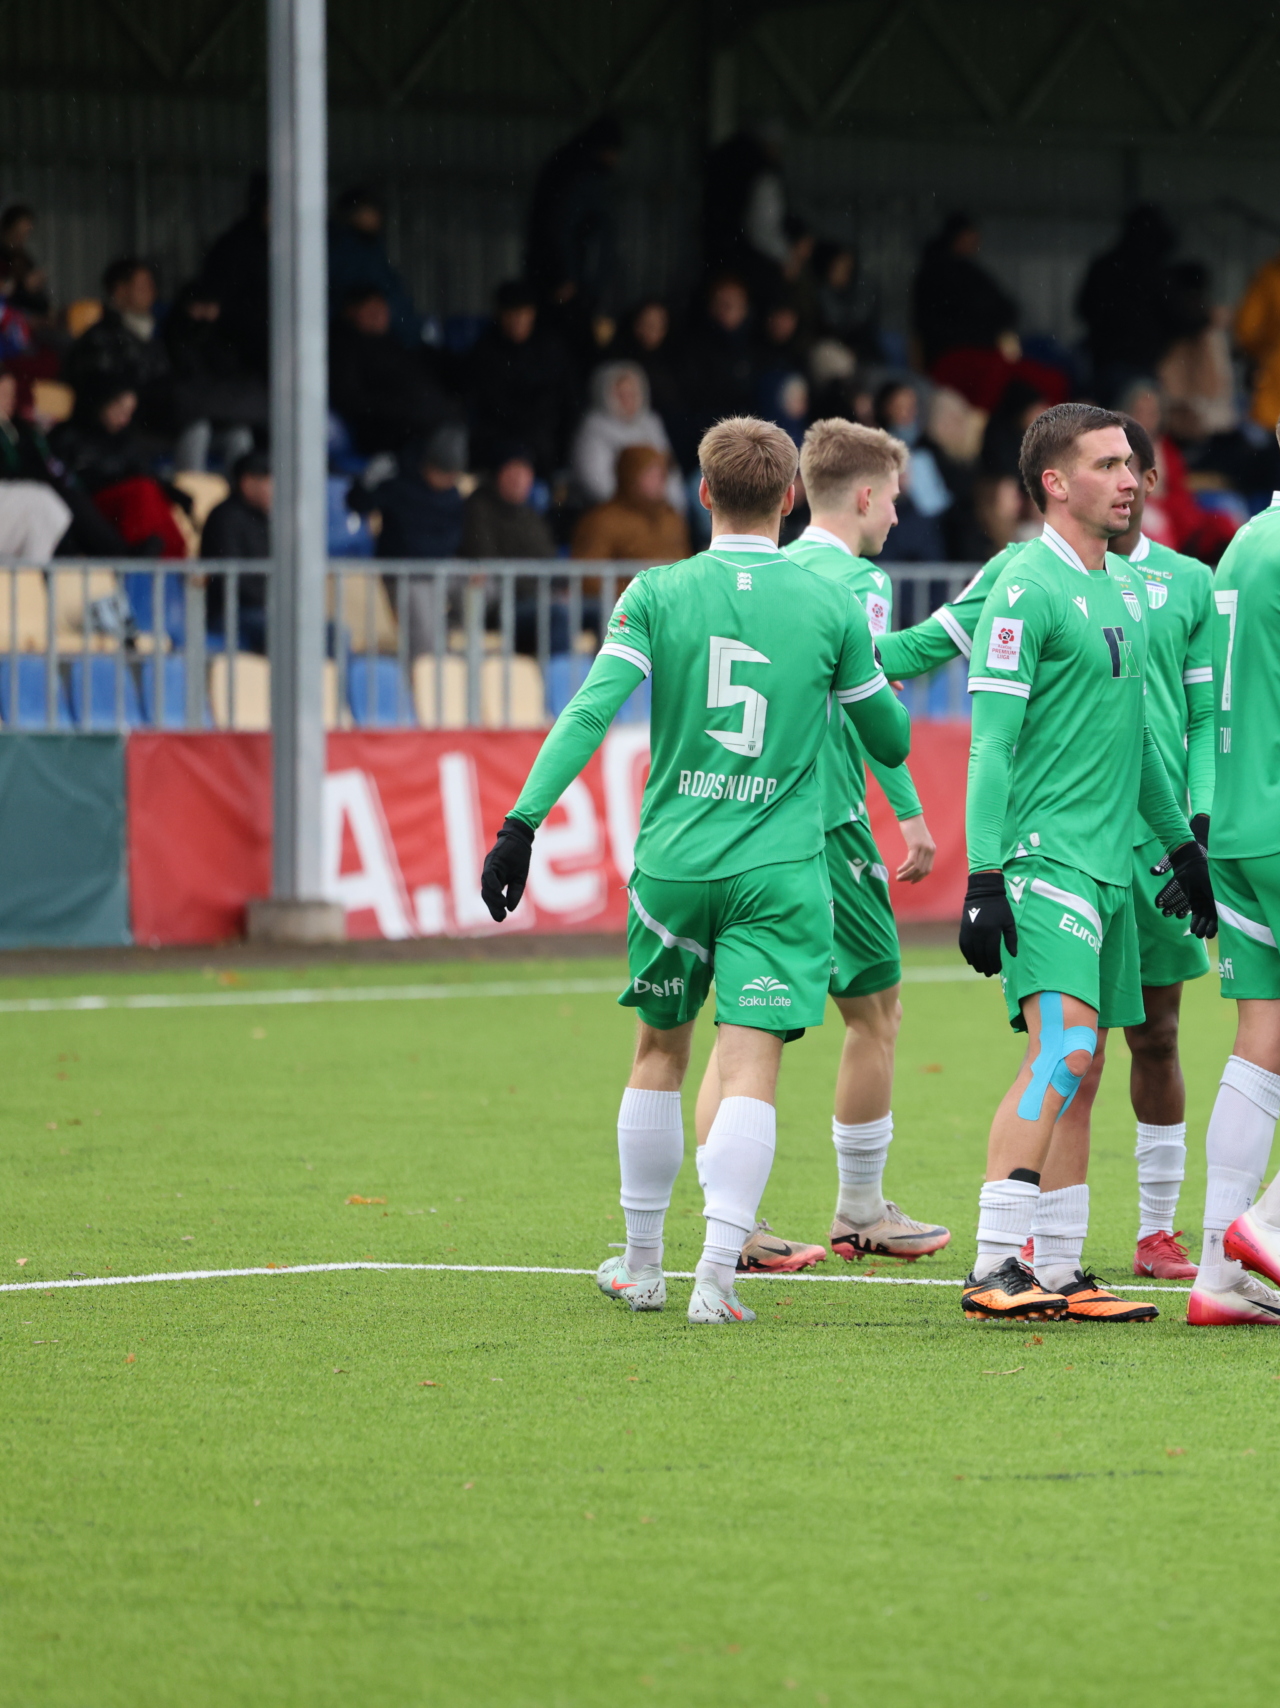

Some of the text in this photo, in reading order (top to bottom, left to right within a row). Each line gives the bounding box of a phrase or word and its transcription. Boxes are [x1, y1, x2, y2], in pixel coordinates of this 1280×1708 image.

[704, 635, 772, 758] 5
[678, 770, 778, 804] ROOSNUPP
[633, 976, 685, 998] Delfi
[738, 994, 792, 1008] Saku Läte
